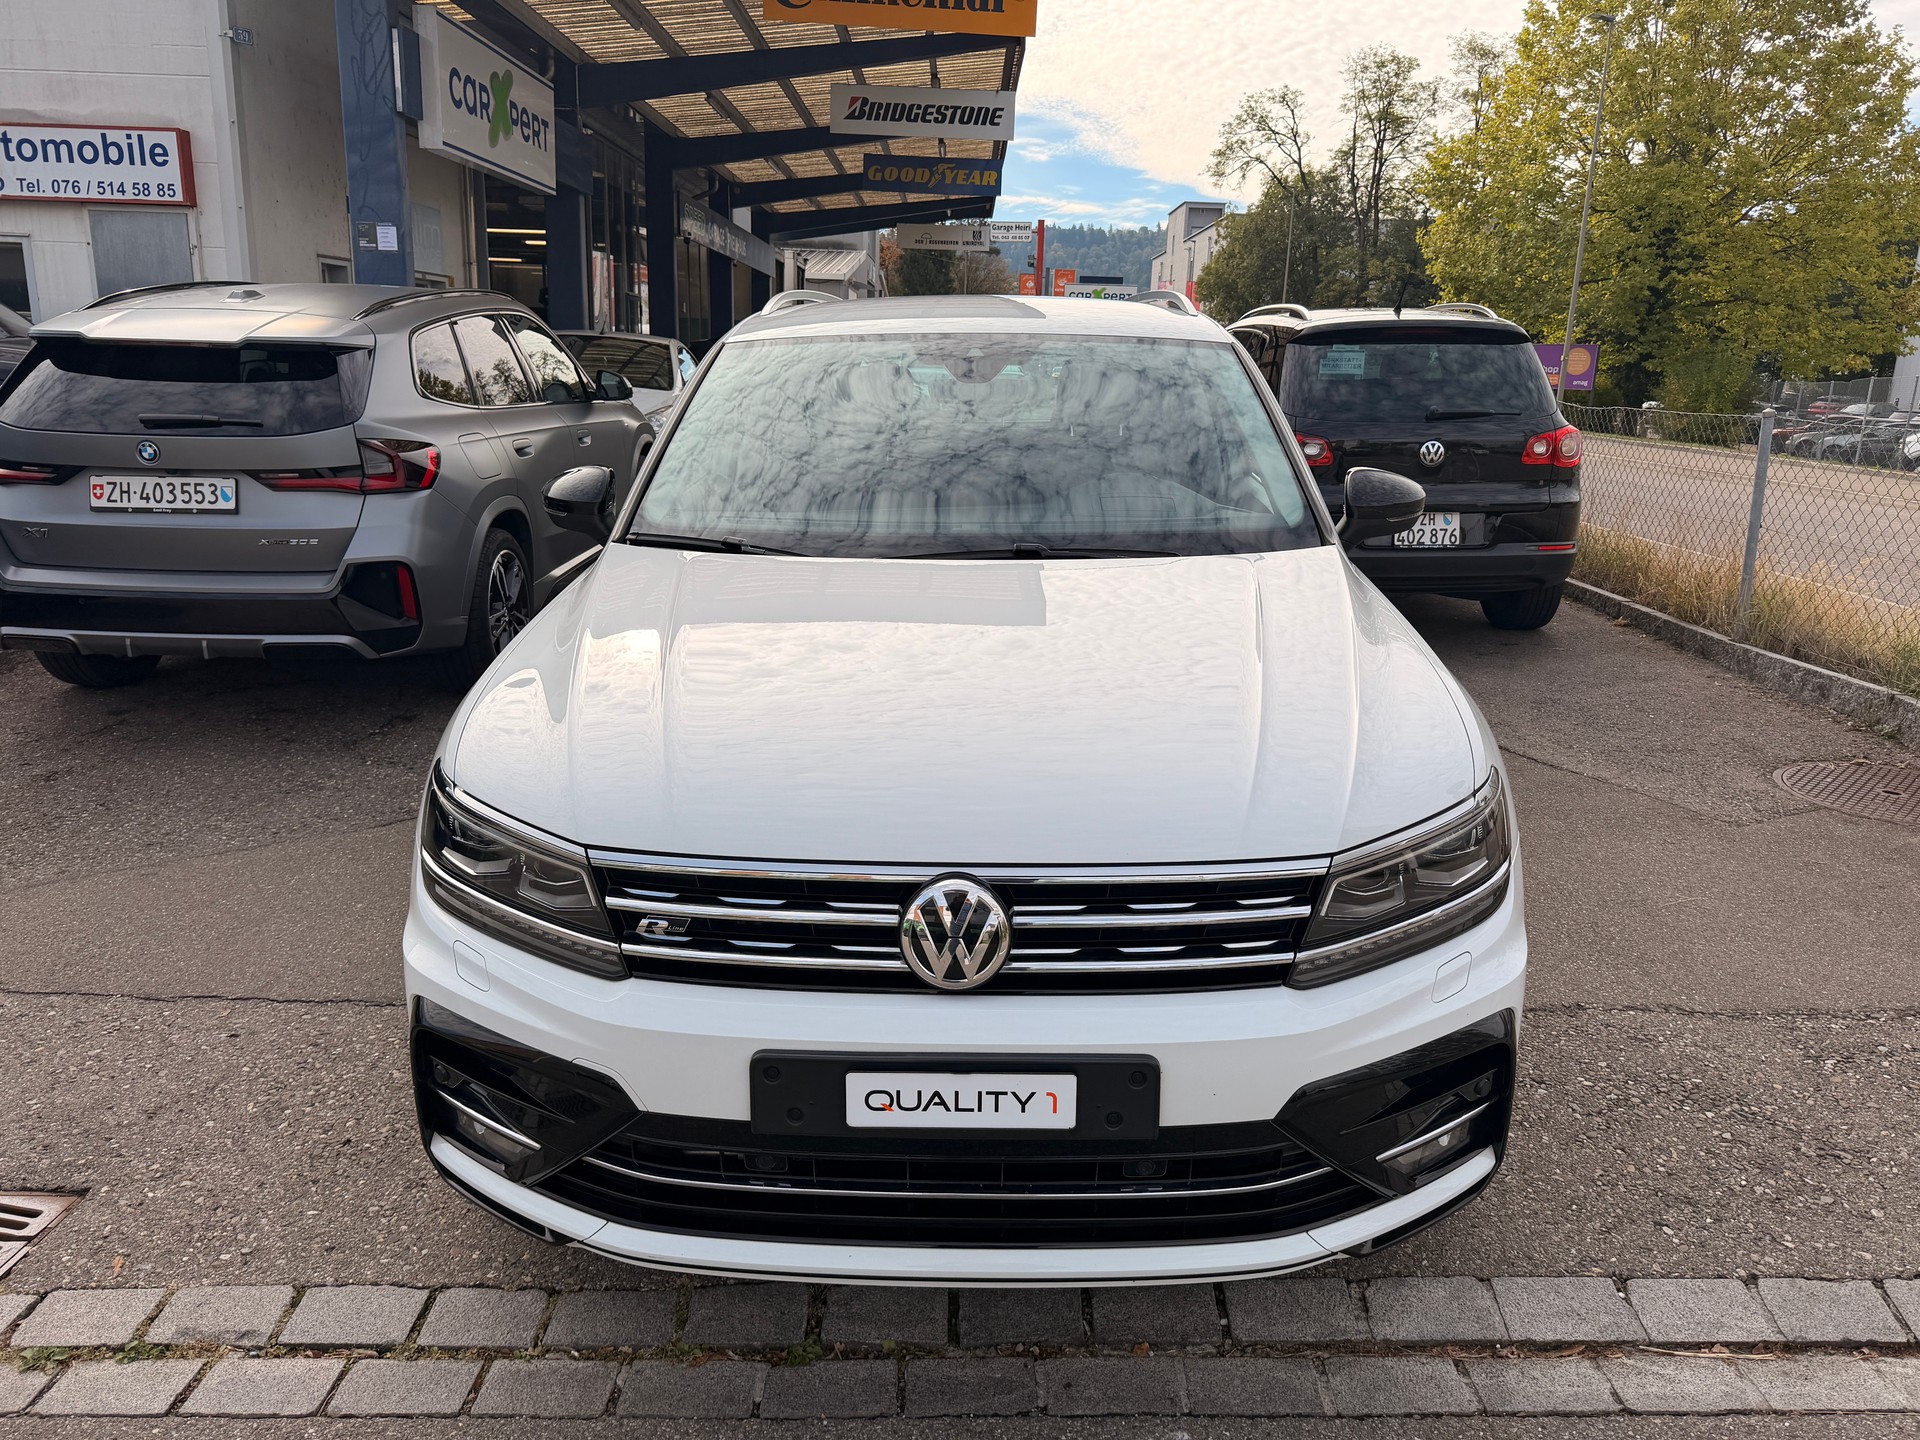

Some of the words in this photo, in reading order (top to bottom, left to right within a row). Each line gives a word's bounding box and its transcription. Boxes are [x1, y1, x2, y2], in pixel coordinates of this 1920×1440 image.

[844, 96, 1005, 126] BRIDGESTONE
[16, 178, 46, 193] Tel.
[51, 179, 81, 194] 076
[86, 180, 91, 195] /
[96, 180, 126, 196] 514
[132, 182, 151, 197] 58
[156, 183, 176, 198] 85
[992, 224, 1013, 232] Garage
[1543, 364, 1559, 374] hop
[1420, 513, 1436, 526] ZH
[23, 526, 48, 538] X1
[1396, 528, 1426, 545] 402
[1430, 528, 1458, 545] 876
[864, 1089, 1037, 1114] QUALITY
[1045, 1091, 1058, 1114] 1
